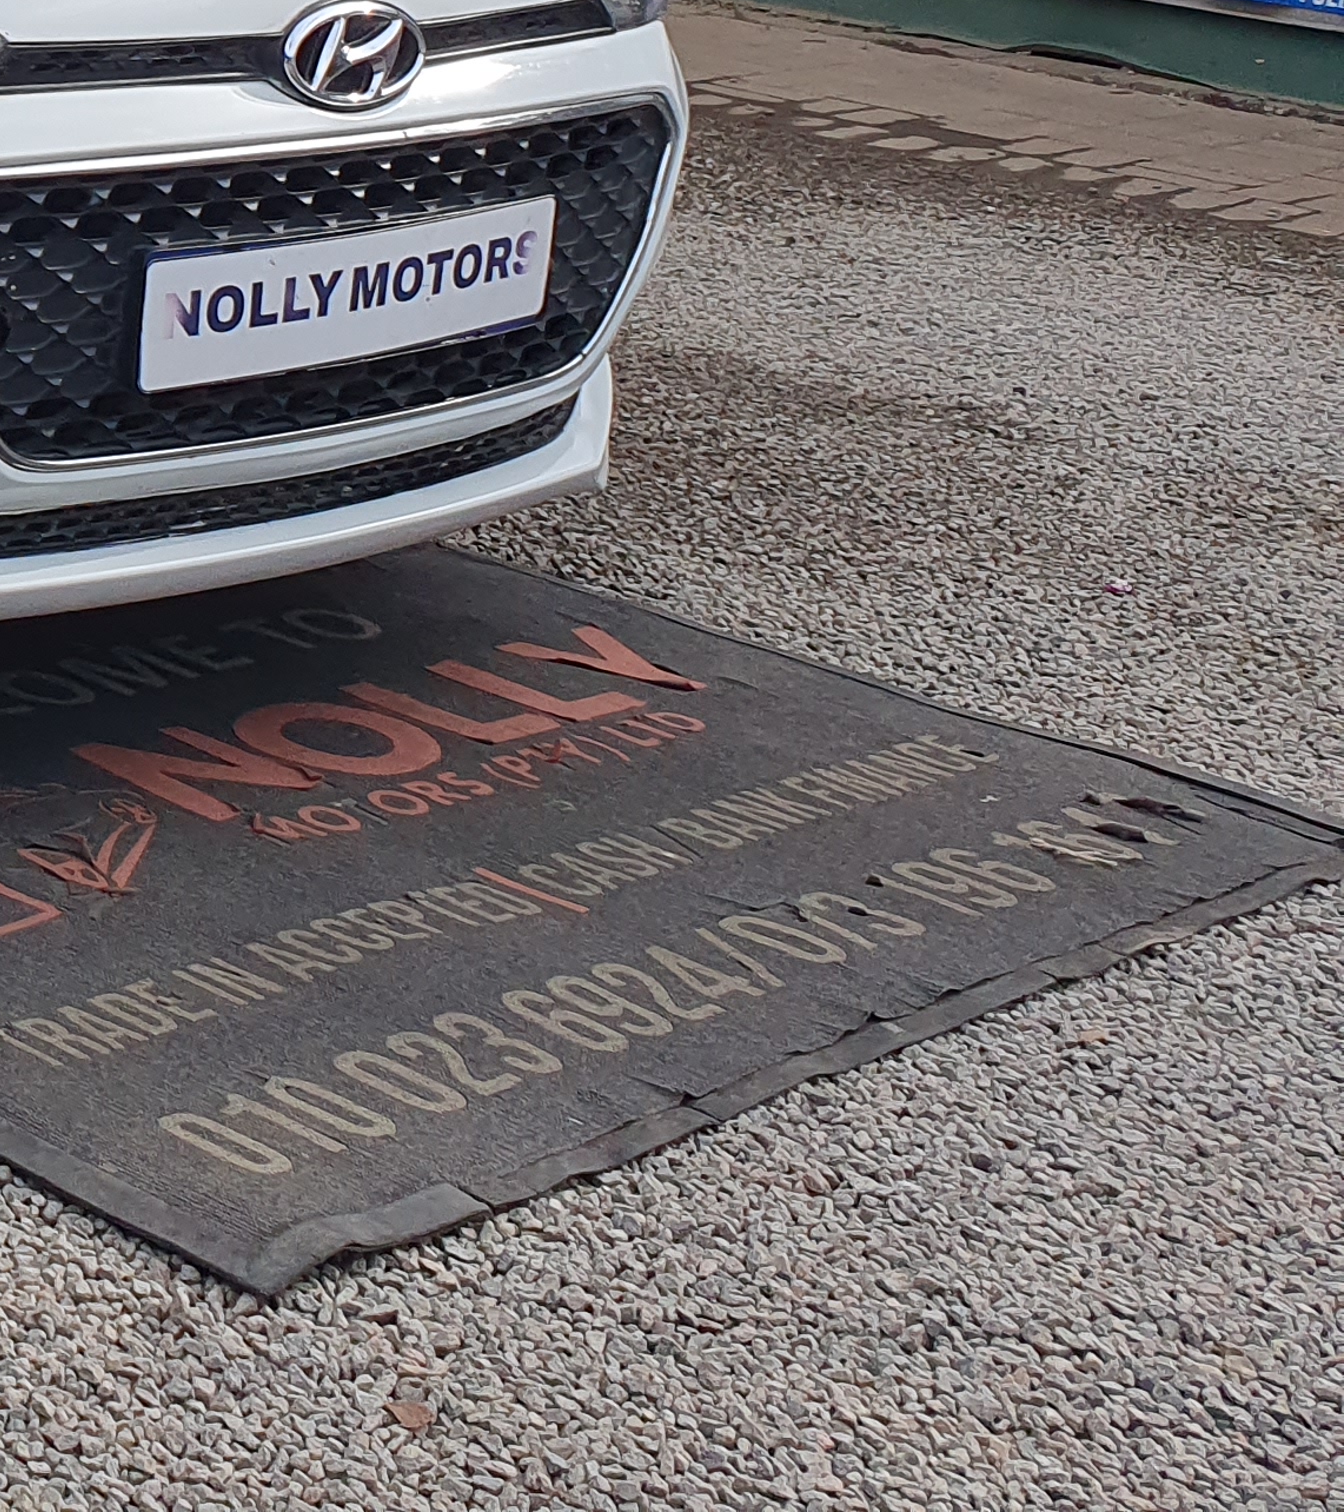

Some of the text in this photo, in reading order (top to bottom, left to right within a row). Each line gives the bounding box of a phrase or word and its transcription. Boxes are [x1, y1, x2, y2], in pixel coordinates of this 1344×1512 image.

[165, 230, 539, 339] NOLLY MOTORS
[223, 608, 384, 650] TO
[71, 623, 708, 822] NOLLY
[171, 956, 286, 1006] IN
[245, 881, 544, 983] ACCEPTED
[158, 1072, 399, 1176] 010
[332, 1011, 562, 1114] 023
[865, 847, 1057, 918] 196
